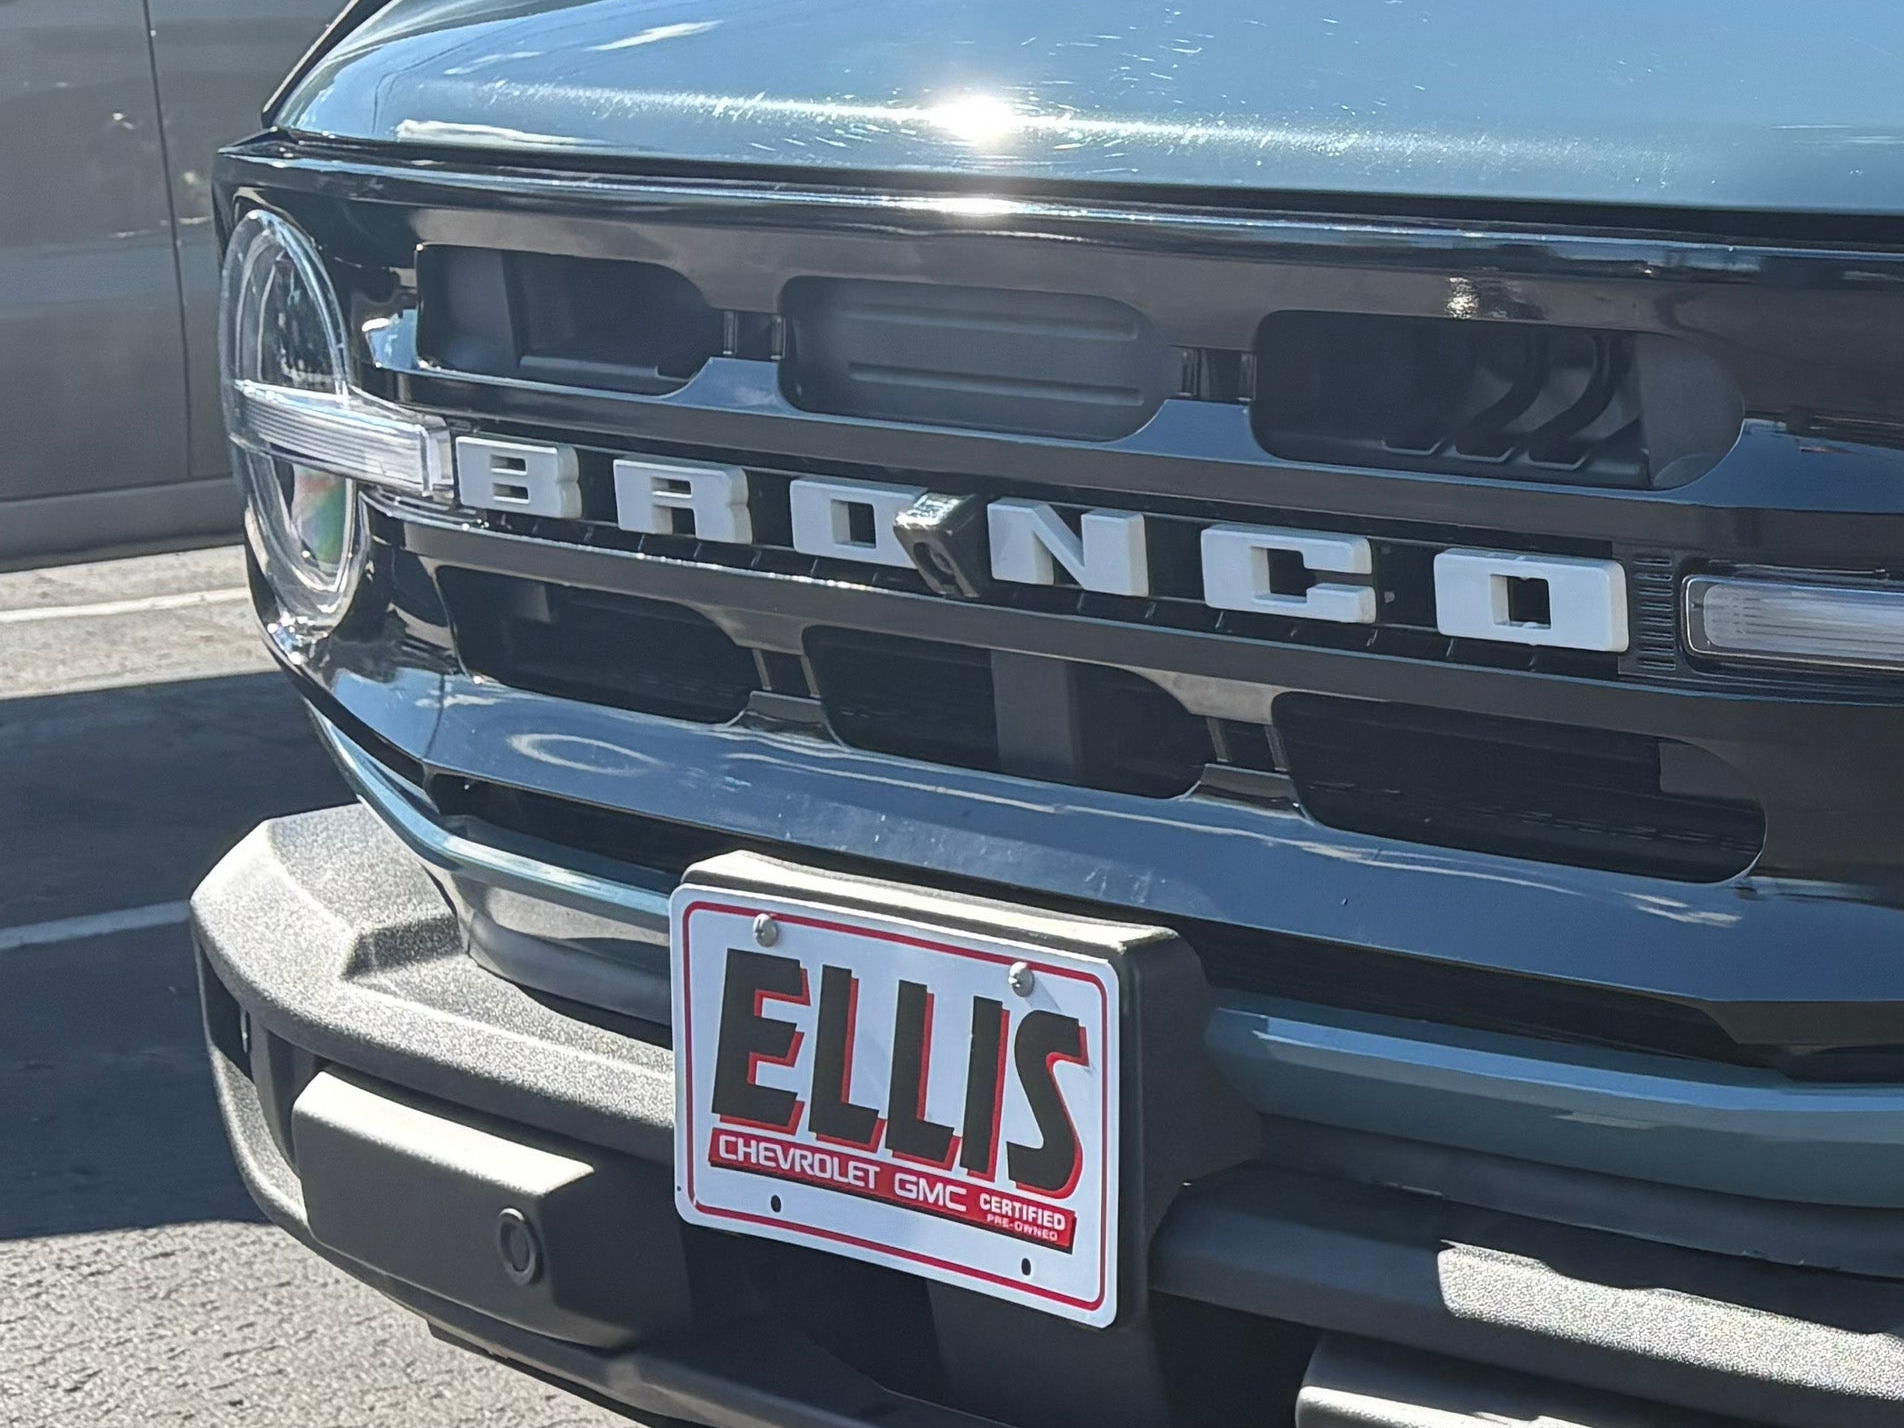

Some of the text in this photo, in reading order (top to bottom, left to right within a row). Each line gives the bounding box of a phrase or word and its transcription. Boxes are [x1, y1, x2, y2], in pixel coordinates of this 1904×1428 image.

[455, 434, 1630, 654] BRONCO
[711, 949, 1089, 1199] ELLIS
[717, 1135, 1066, 1232] CHEVROLET GMC CERTIFIED
[986, 1213, 1059, 1242] PRE-OWNED
